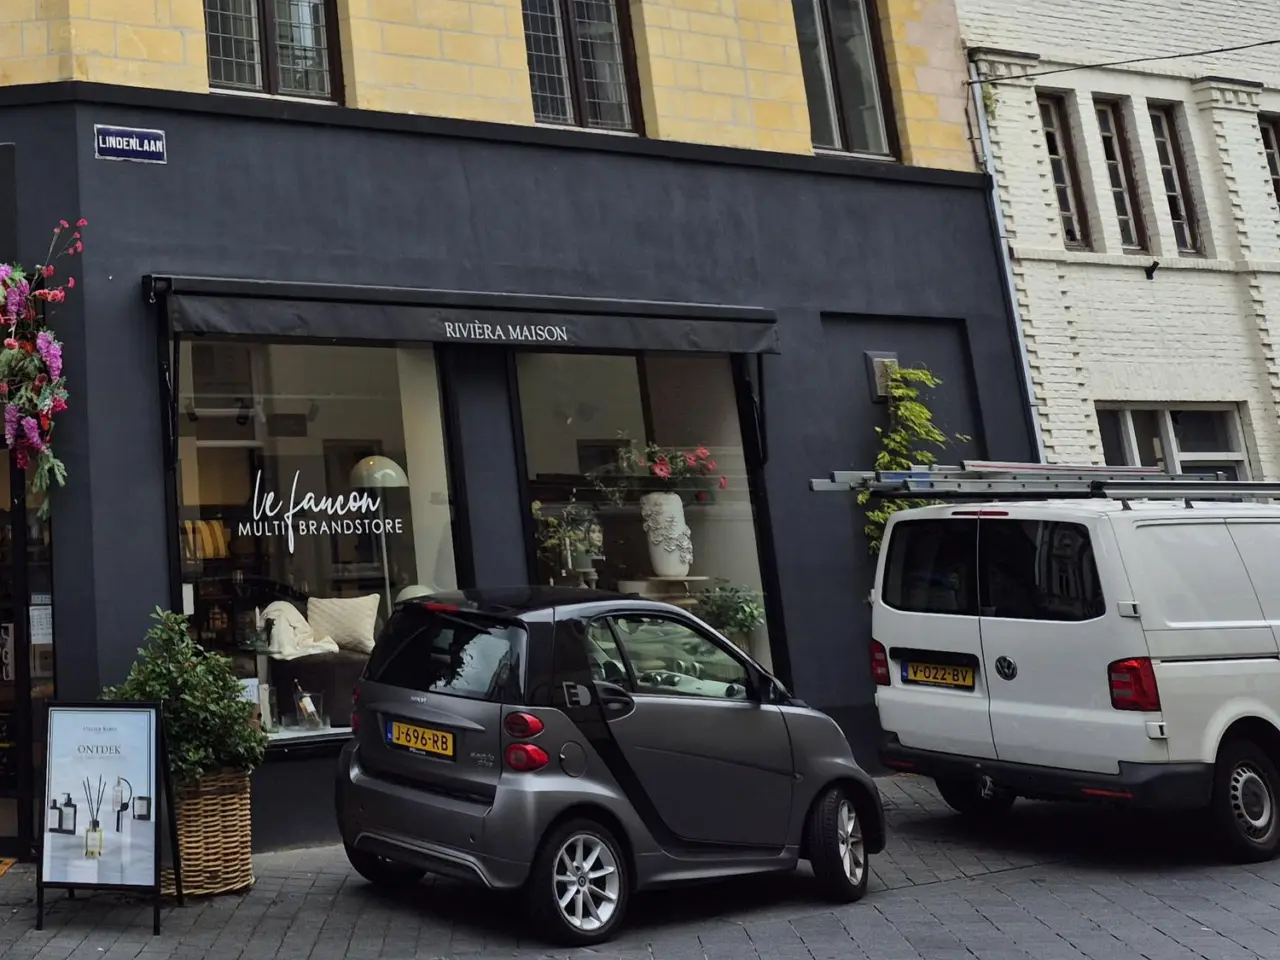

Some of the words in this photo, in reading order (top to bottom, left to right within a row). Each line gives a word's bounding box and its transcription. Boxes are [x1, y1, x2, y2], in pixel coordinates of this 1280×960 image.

[99, 135, 163, 152] LINDENLAAN
[444, 320, 506, 340] RIVIÈRA
[508, 324, 568, 341] MAISON
[253, 469, 283, 520] le
[238, 520, 285, 537] MULTI
[299, 518, 403, 535] BRANDSTORE
[911, 664, 969, 684] V-022-BV
[395, 725, 449, 751] J-696-RB
[77, 744, 121, 755] ONTDEK
